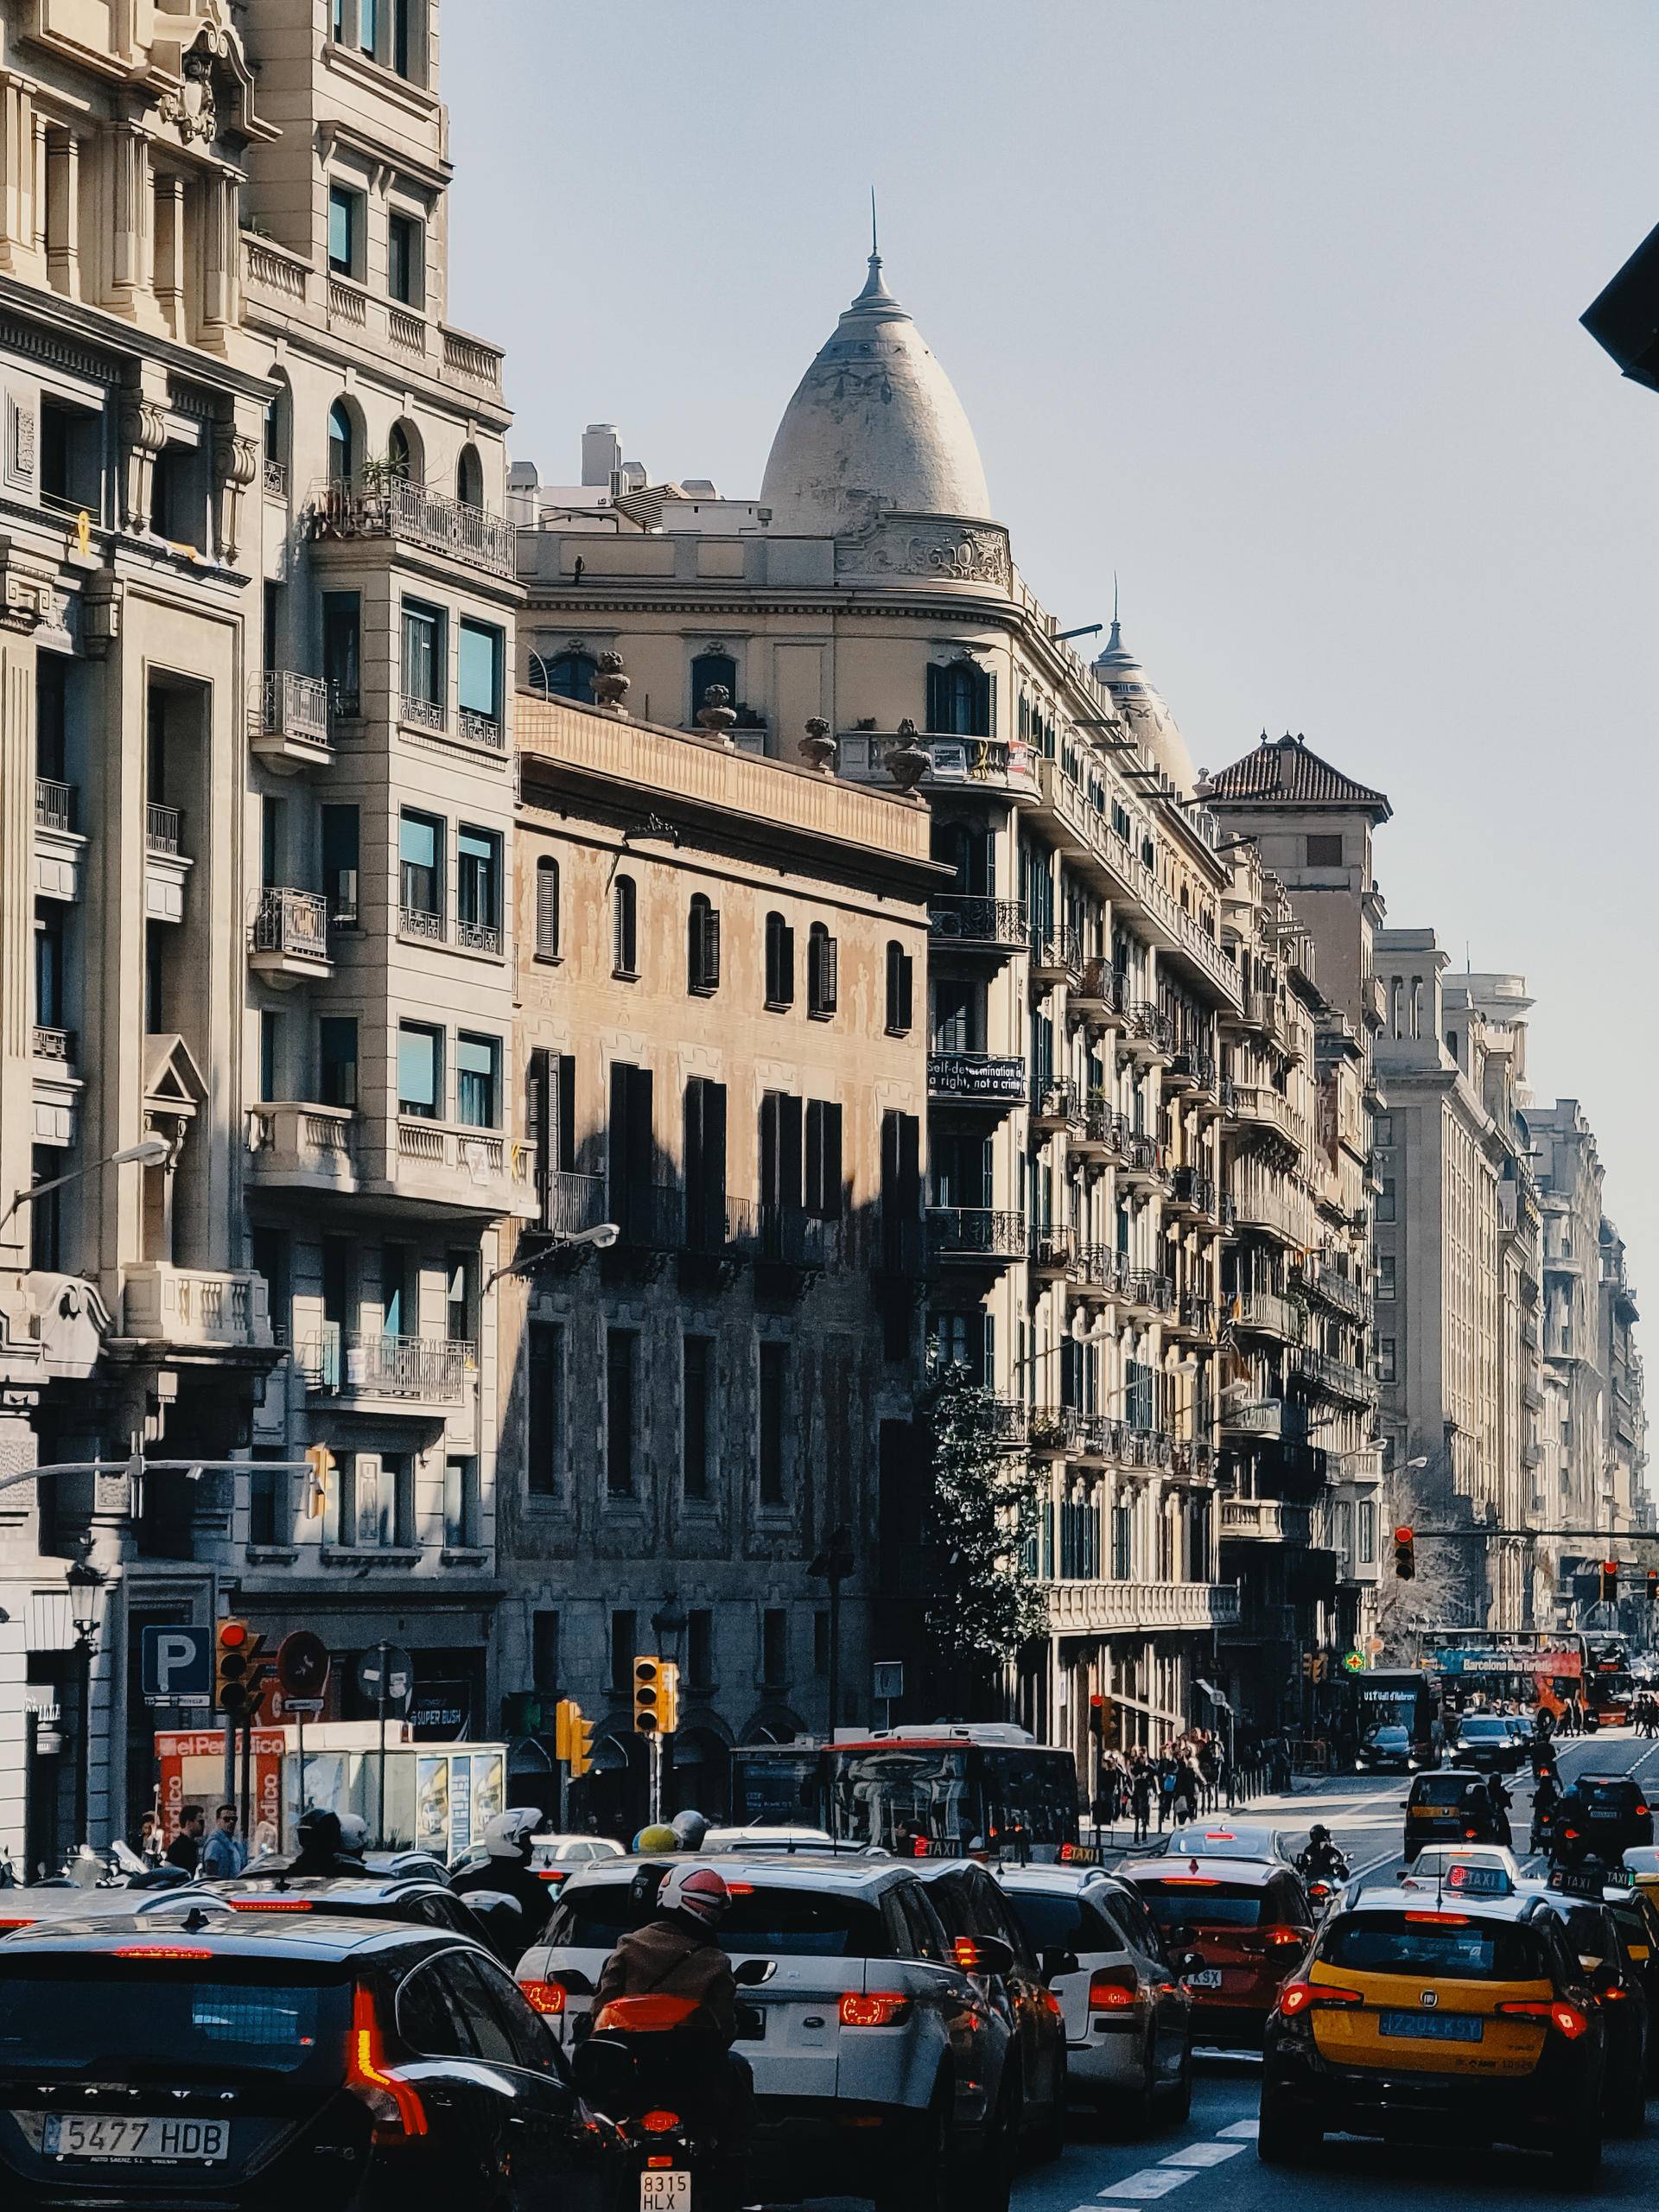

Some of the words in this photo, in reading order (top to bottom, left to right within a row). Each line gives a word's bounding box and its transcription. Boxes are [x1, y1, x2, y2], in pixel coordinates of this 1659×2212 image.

[941, 1074, 970, 1089] right,
[975, 1077, 990, 1089] not
[993, 1080, 999, 1089] a
[157, 1635, 196, 1688] P
[1463, 1658, 1506, 1672] Barcelona
[417, 1710, 441, 1726] SUPER
[927, 1841, 956, 1857] TAXI
[1469, 1872, 1496, 1887] TAXI
[1567, 1876, 1591, 1890] TAXI
[1607, 1872, 1628, 1884] TAXI
[1193, 1971, 1218, 1984] KSX
[68, 2120, 149, 2152] 5477
[161, 2123, 222, 2155] HDB
[645, 2176, 686, 2192] 8315
[644, 2194, 675, 2210] HLX
